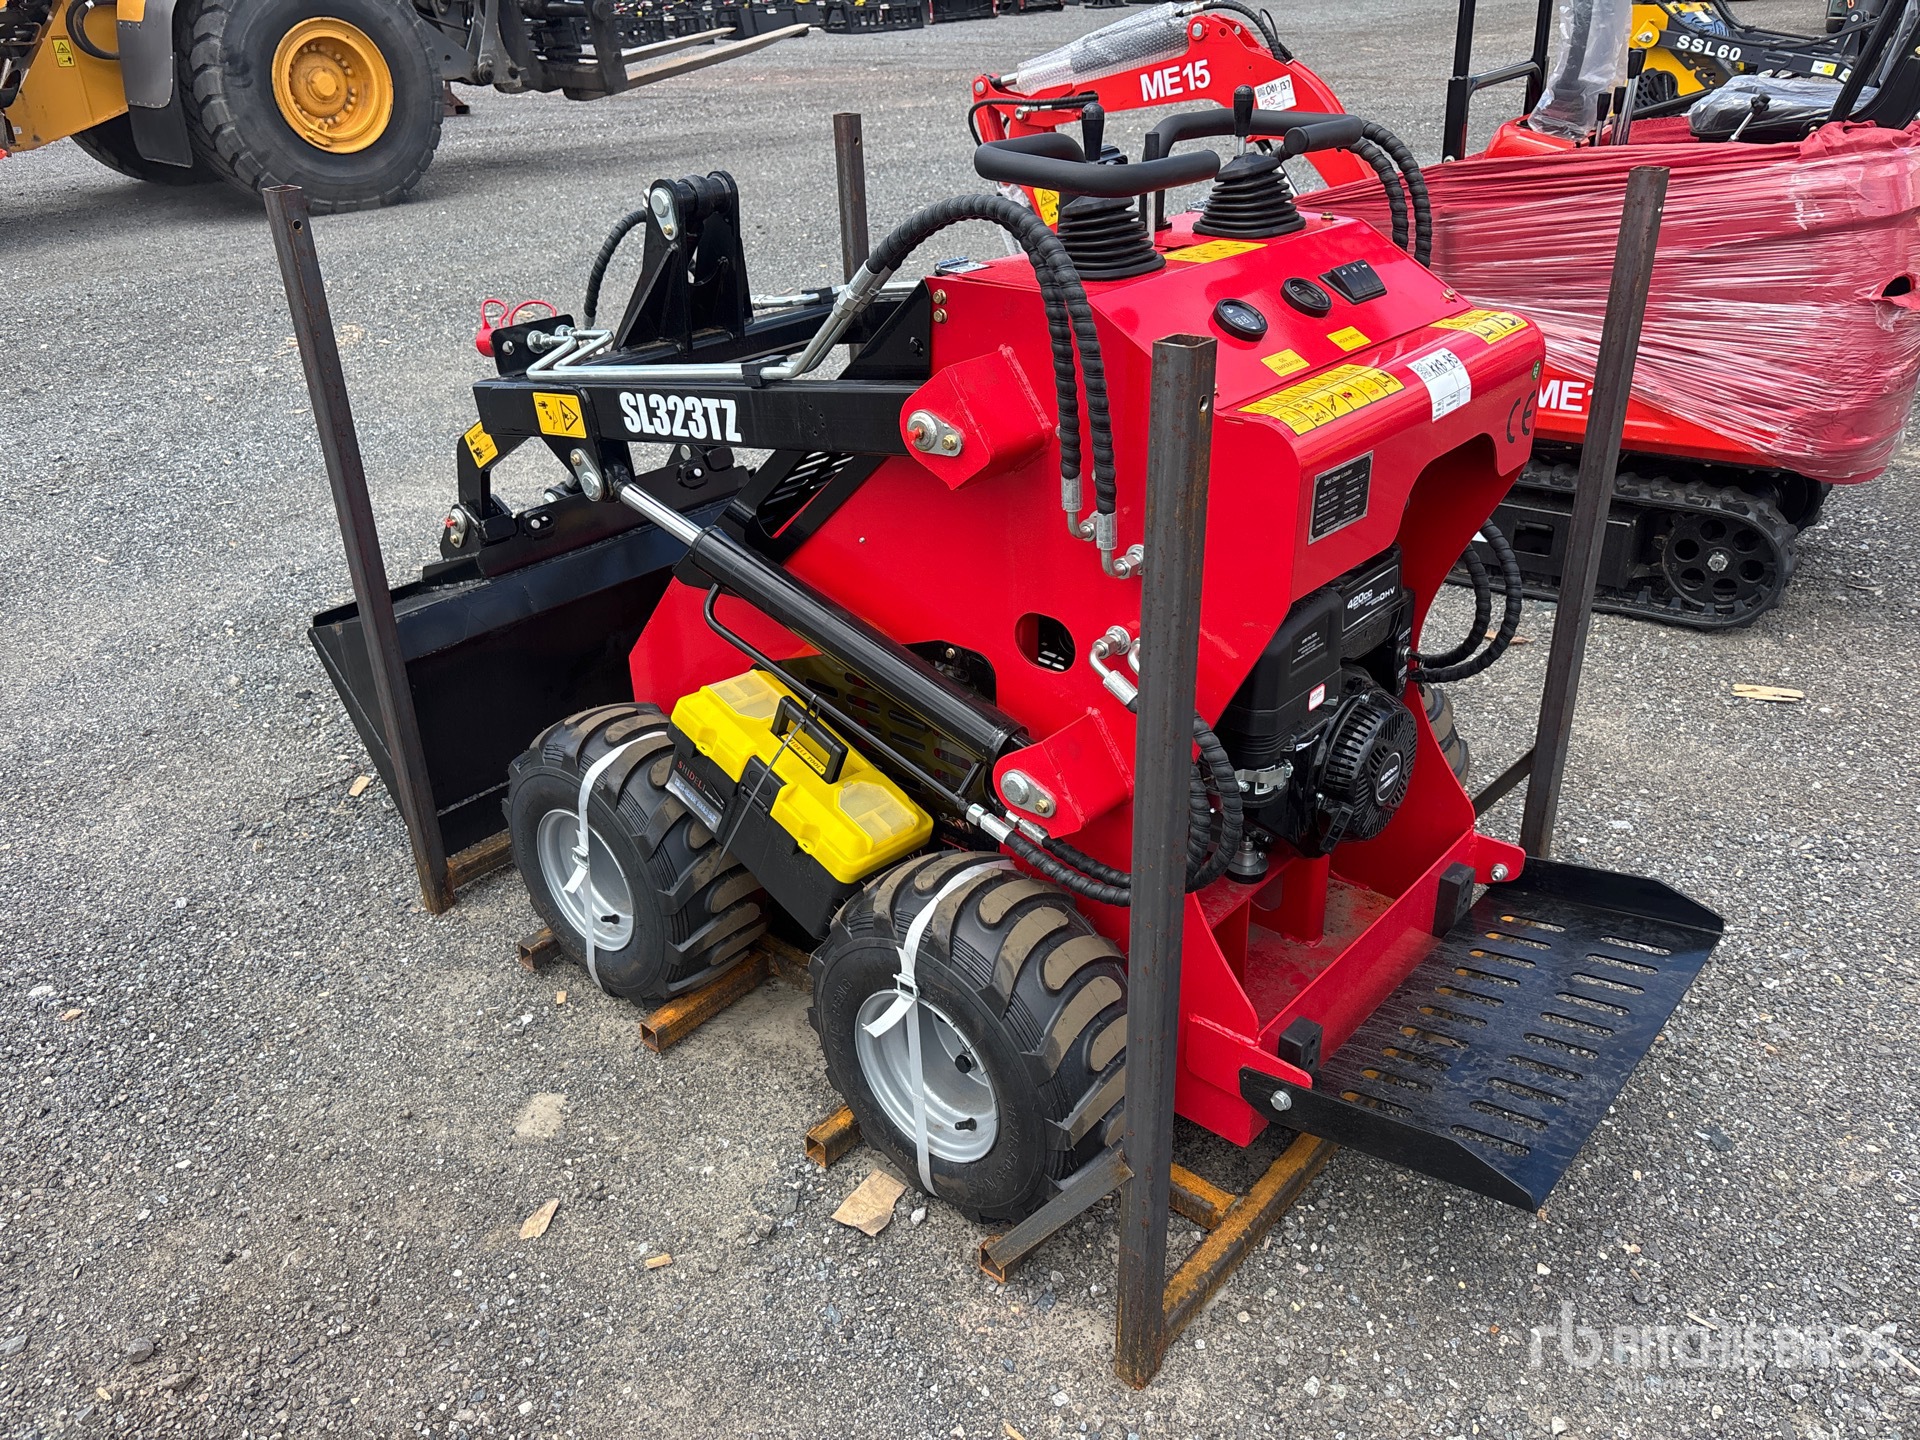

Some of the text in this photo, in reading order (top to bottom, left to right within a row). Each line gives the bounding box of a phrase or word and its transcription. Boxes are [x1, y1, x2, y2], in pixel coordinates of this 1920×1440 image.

[1676, 35, 1742, 61] SSL60
[1140, 58, 1211, 102] ME15
[1538, 379, 1593, 412] ME
[619, 391, 742, 443] SL323TZ
[1506, 389, 1536, 444] CE
[1347, 588, 1373, 610] 420cc
[1379, 586, 1396, 601] OHV
